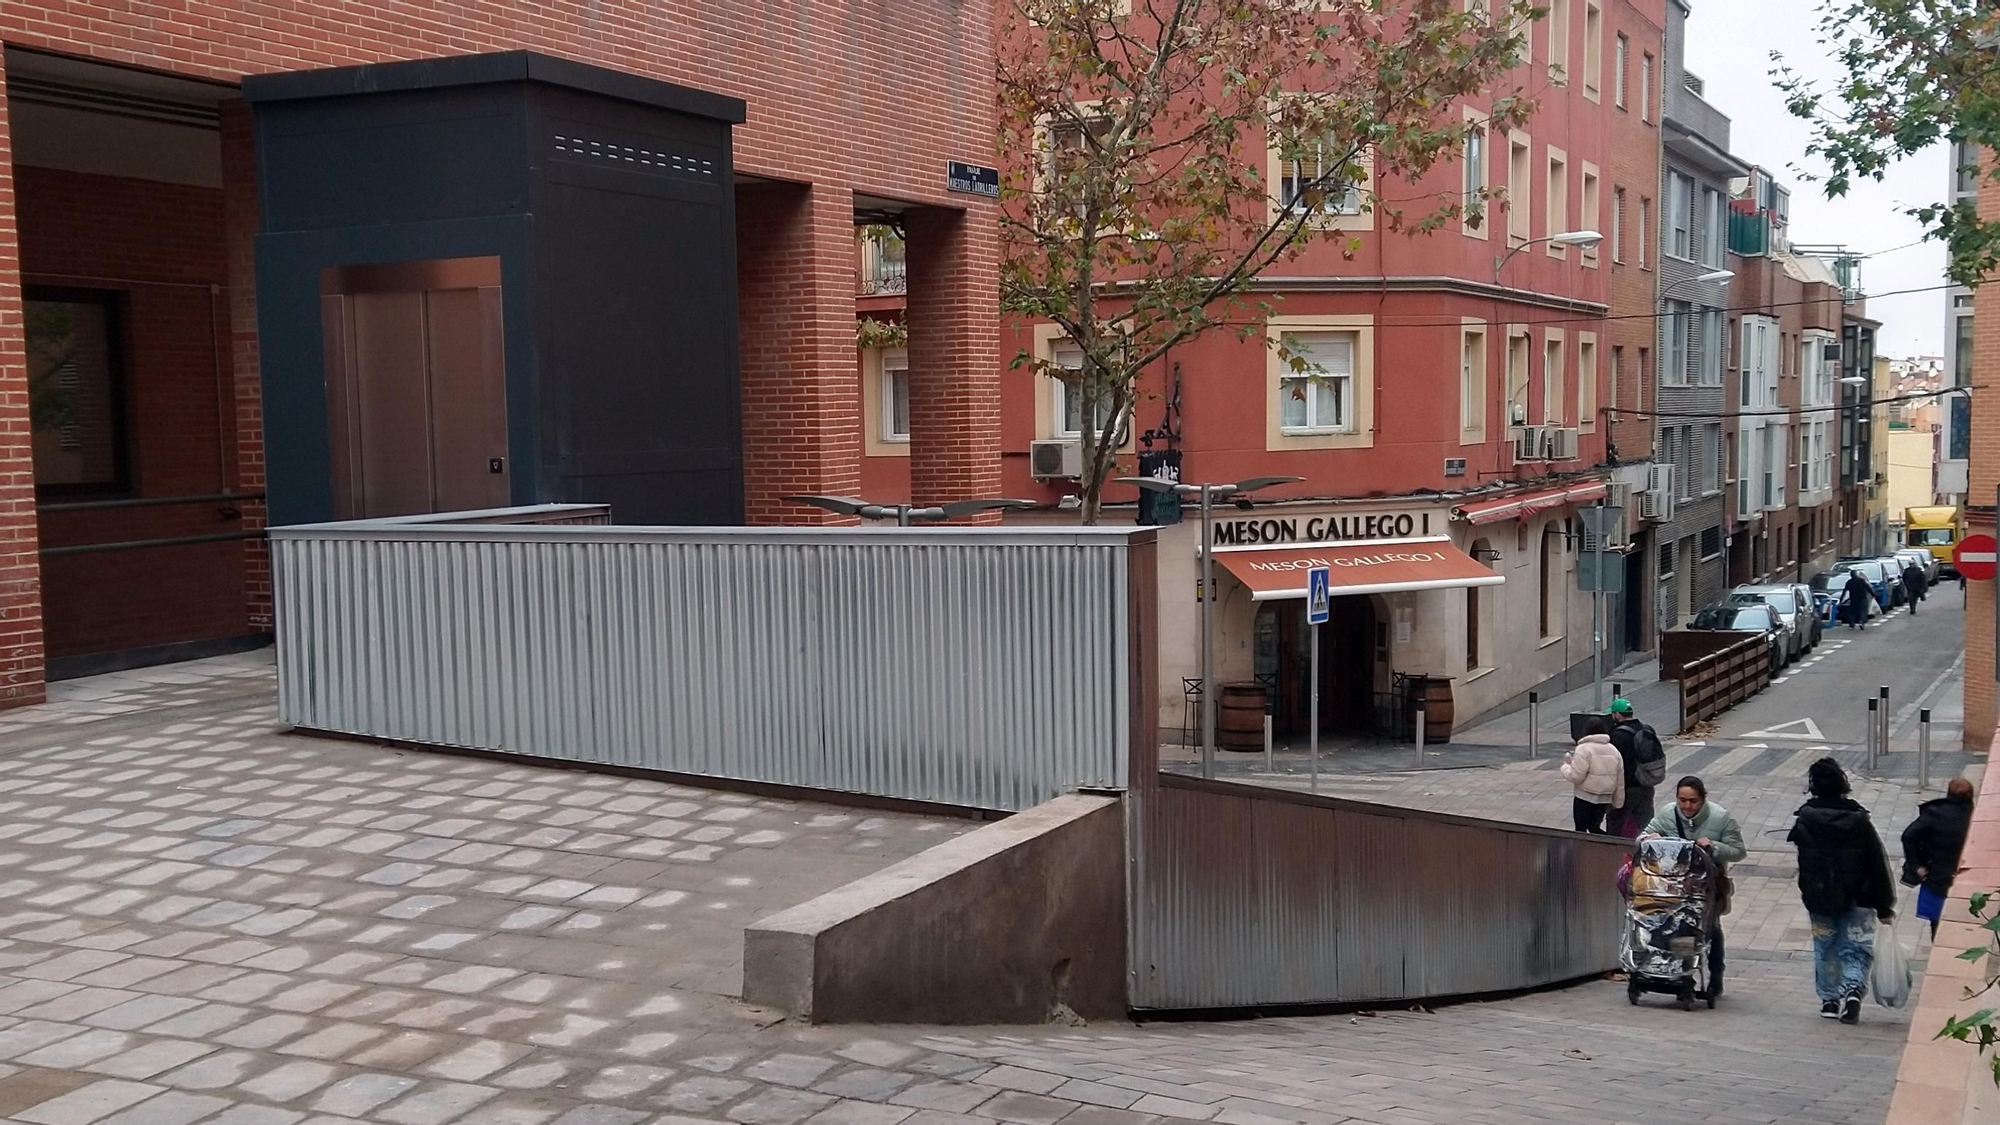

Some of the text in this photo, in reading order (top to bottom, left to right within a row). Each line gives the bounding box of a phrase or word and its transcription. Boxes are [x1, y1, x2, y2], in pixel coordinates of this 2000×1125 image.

[1214, 513, 1429, 545] MESON GALLEGO I
[1249, 552, 1446, 571] MESON GALLEGO I
